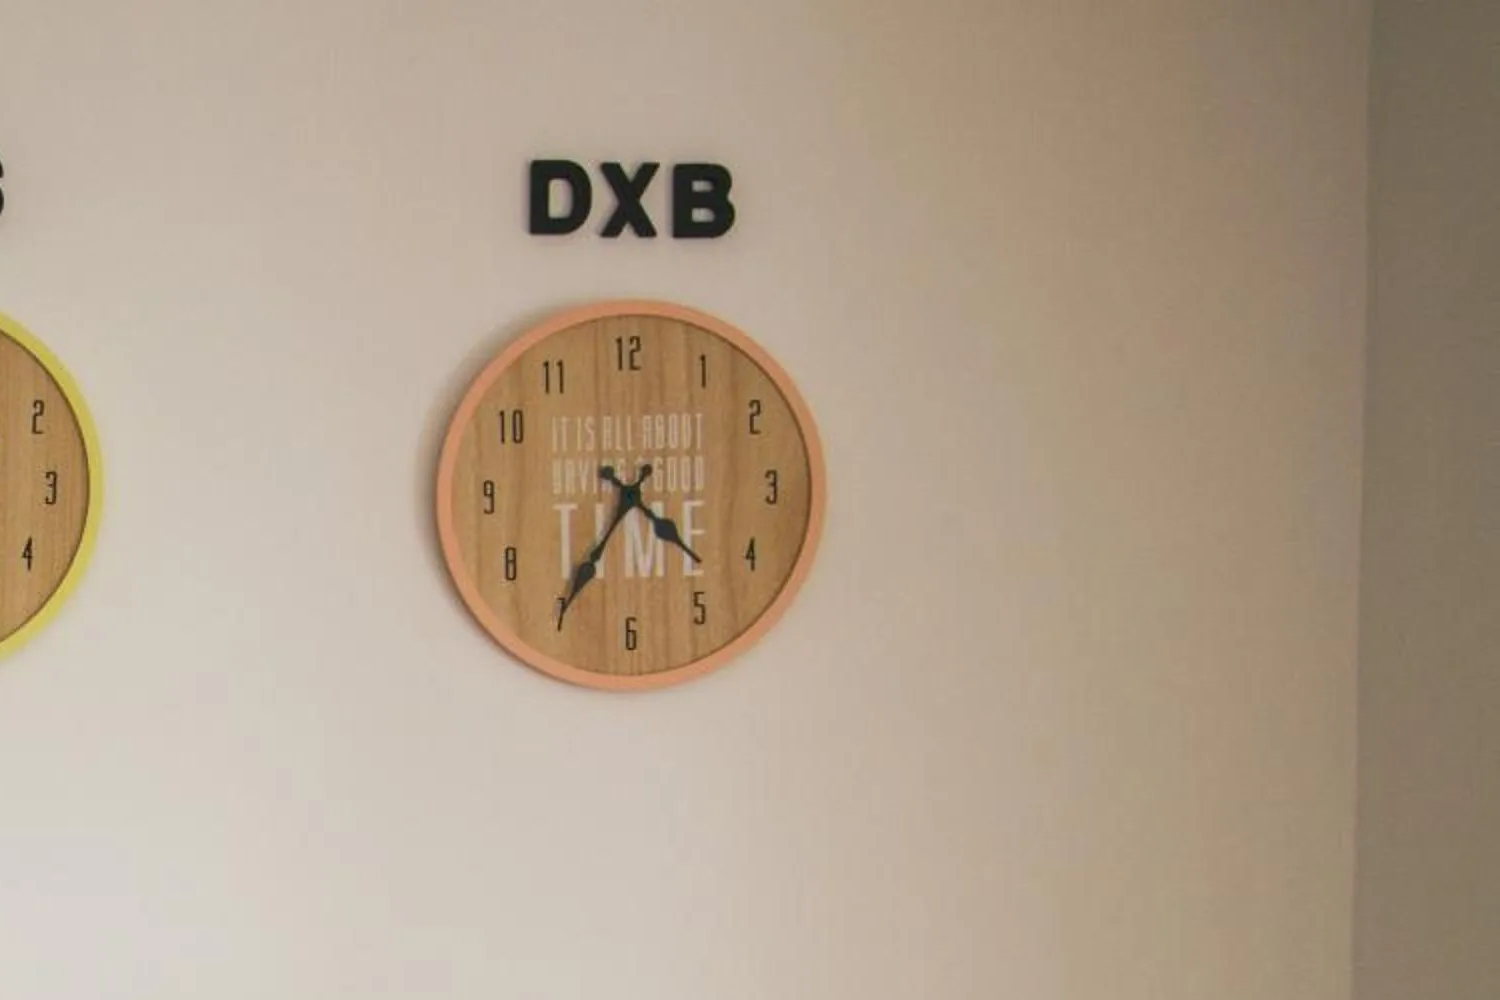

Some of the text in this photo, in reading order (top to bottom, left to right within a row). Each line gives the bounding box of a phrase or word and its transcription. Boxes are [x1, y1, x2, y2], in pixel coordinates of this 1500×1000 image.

[529, 159, 736, 238] DXB
[615, 336, 642, 370] 12
[542, 360, 564, 393] 11
[699, 354, 707, 388] 1
[31, 400, 45, 434] 2
[499, 410, 524, 443] 10
[552, 413, 703, 451] IT IS ALL ABOUT
[748, 400, 762, 434] 2
[44, 471, 58, 505] 3
[653, 456, 705, 492] GOOD
[764, 470, 778, 504] 3
[483, 480, 495, 514] 9
[21, 537, 33, 570] 4
[552, 500, 706, 580] TIME
[744, 538, 756, 571] 4
[504, 547, 517, 581] 8
[692, 592, 707, 625] 5
[625, 617, 637, 650] 6
